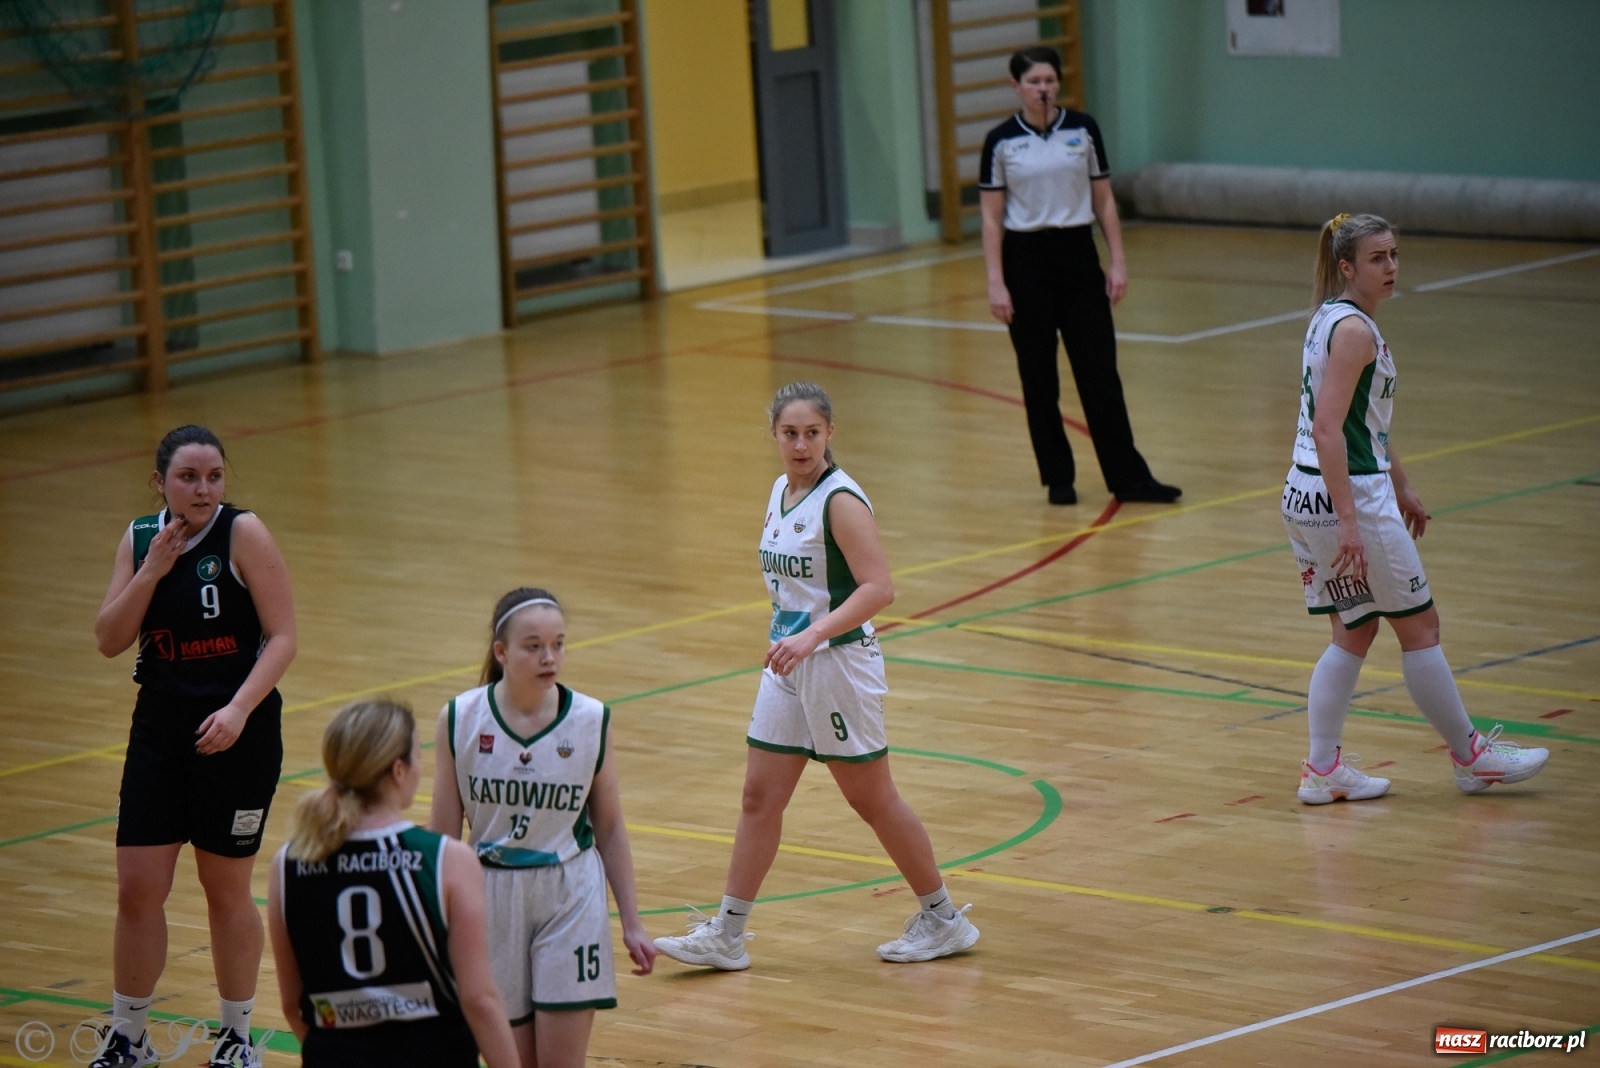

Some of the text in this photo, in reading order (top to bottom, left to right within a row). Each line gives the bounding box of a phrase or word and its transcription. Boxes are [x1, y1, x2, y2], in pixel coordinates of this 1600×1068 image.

[201, 584, 221, 619] 9
[180, 635, 237, 656] KAMAN
[830, 711, 849, 742] 9
[468, 775, 584, 812] KATOWICE
[508, 813, 531, 840] 15
[336, 885, 386, 980] 8
[573, 943, 600, 983] 15
